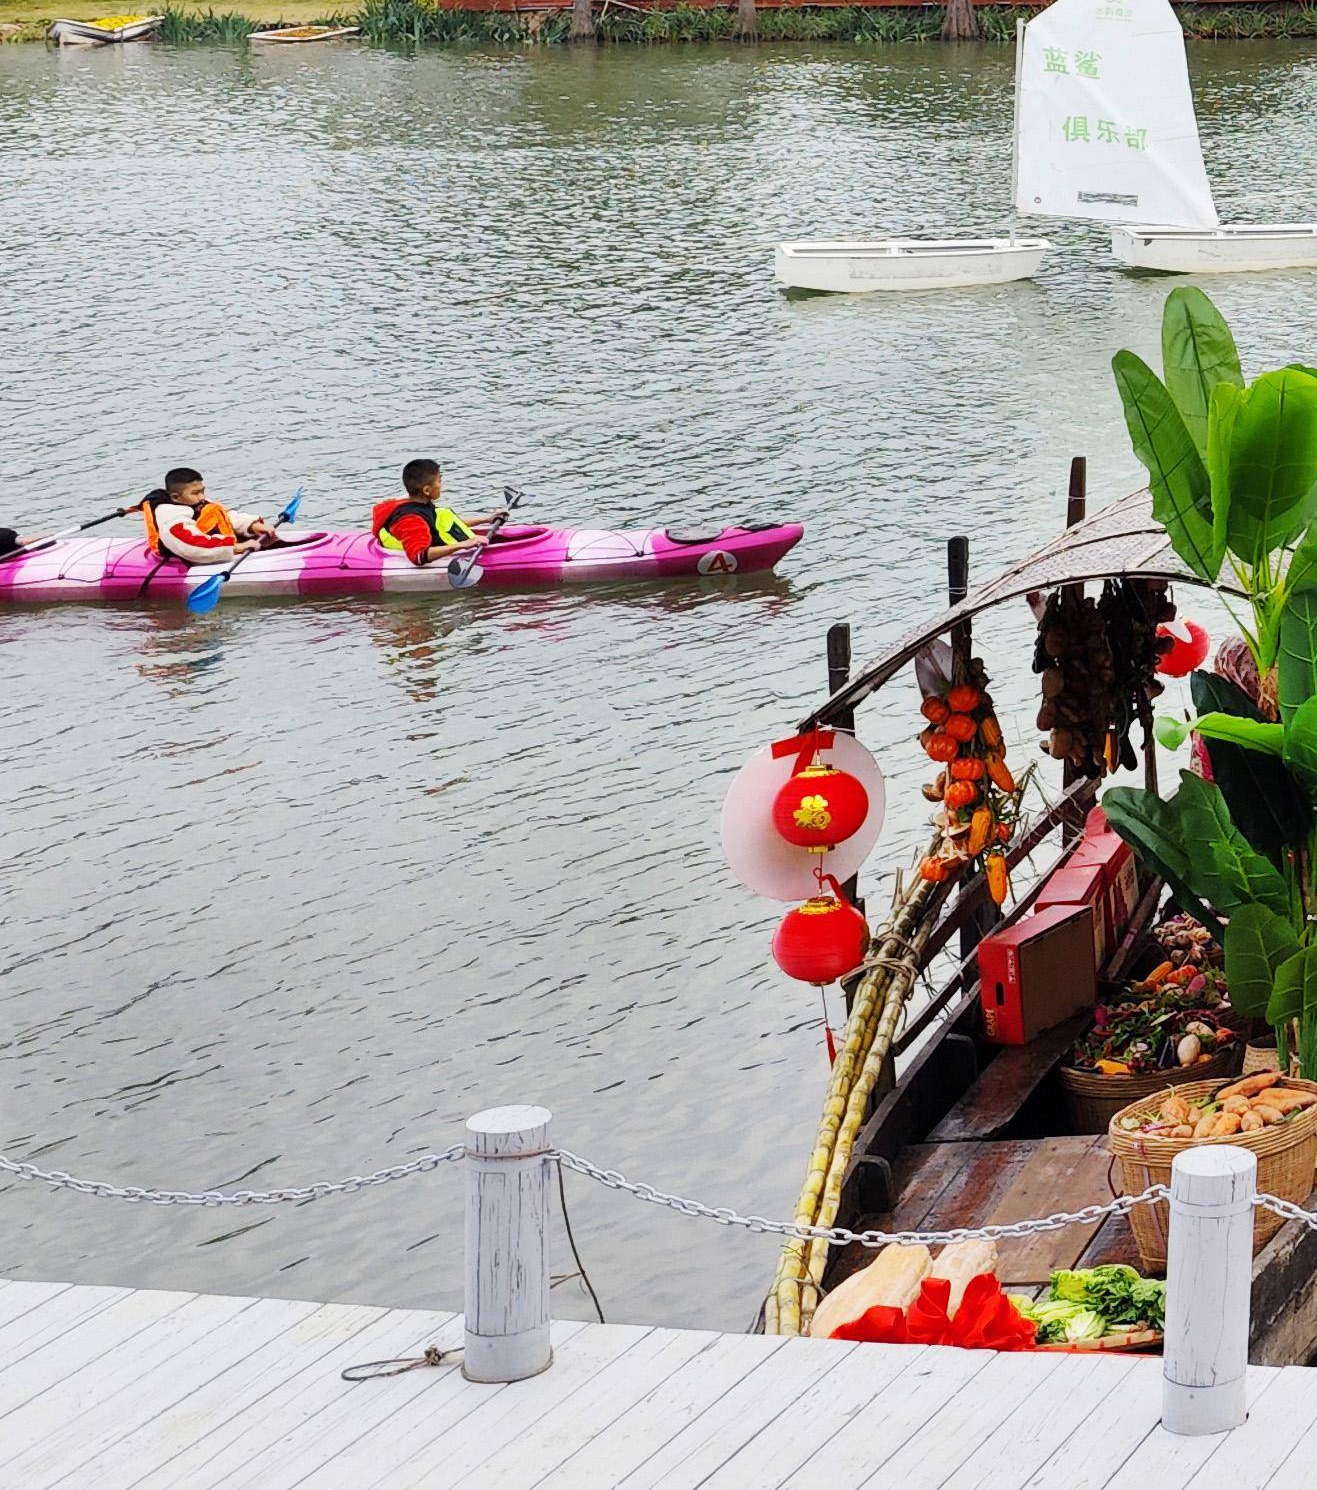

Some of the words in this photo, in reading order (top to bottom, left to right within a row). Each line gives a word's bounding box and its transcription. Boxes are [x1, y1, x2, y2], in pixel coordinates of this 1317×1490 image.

[1044, 47, 1102, 79] 蓝鲨
[1063, 114, 1148, 151] 俱乐部
[708, 553, 733, 571] 4
